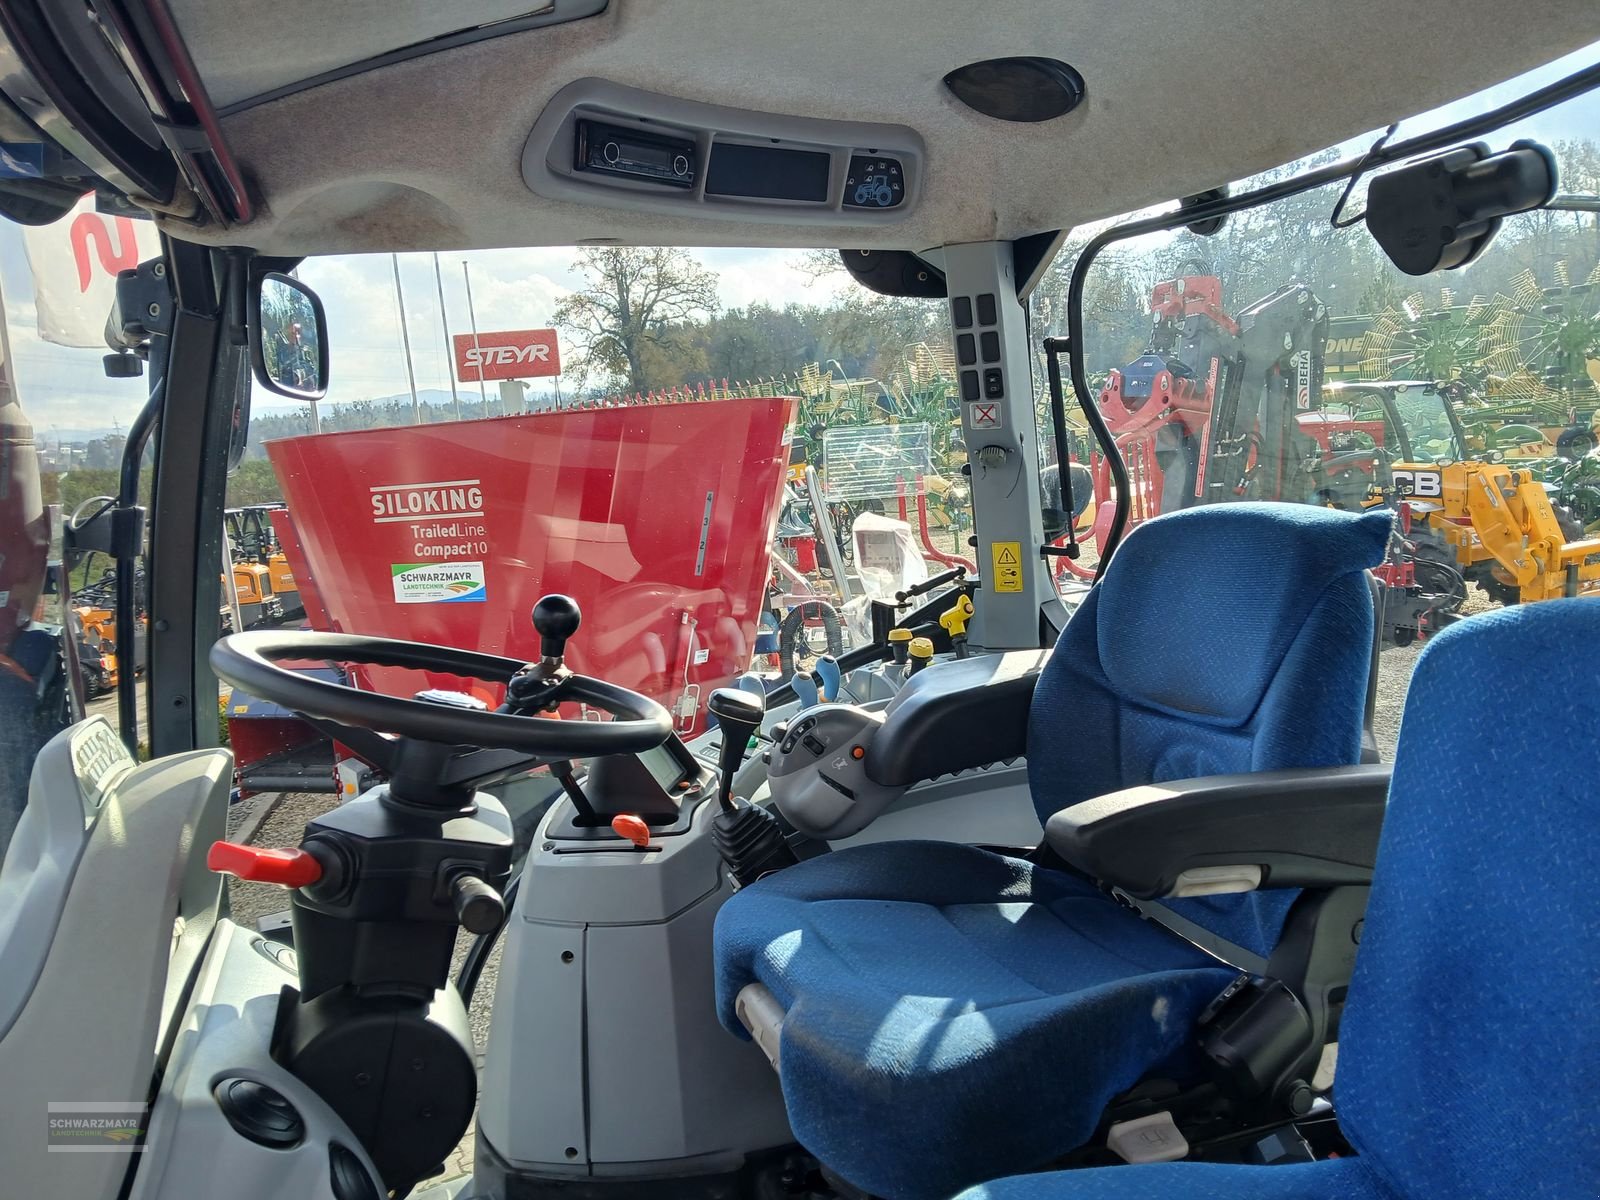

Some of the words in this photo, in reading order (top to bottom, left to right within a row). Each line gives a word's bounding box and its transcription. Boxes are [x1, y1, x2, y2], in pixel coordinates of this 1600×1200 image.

[463, 343, 550, 367] STEYR
[1325, 337, 1364, 353] ONE
[1299, 351, 1309, 386] BEHA
[1391, 471, 1441, 496] CB
[371, 487, 483, 516] SILOKING
[400, 571, 472, 583] SCHWARZMAYR
[403, 583, 445, 591] LANDTECHNIK
